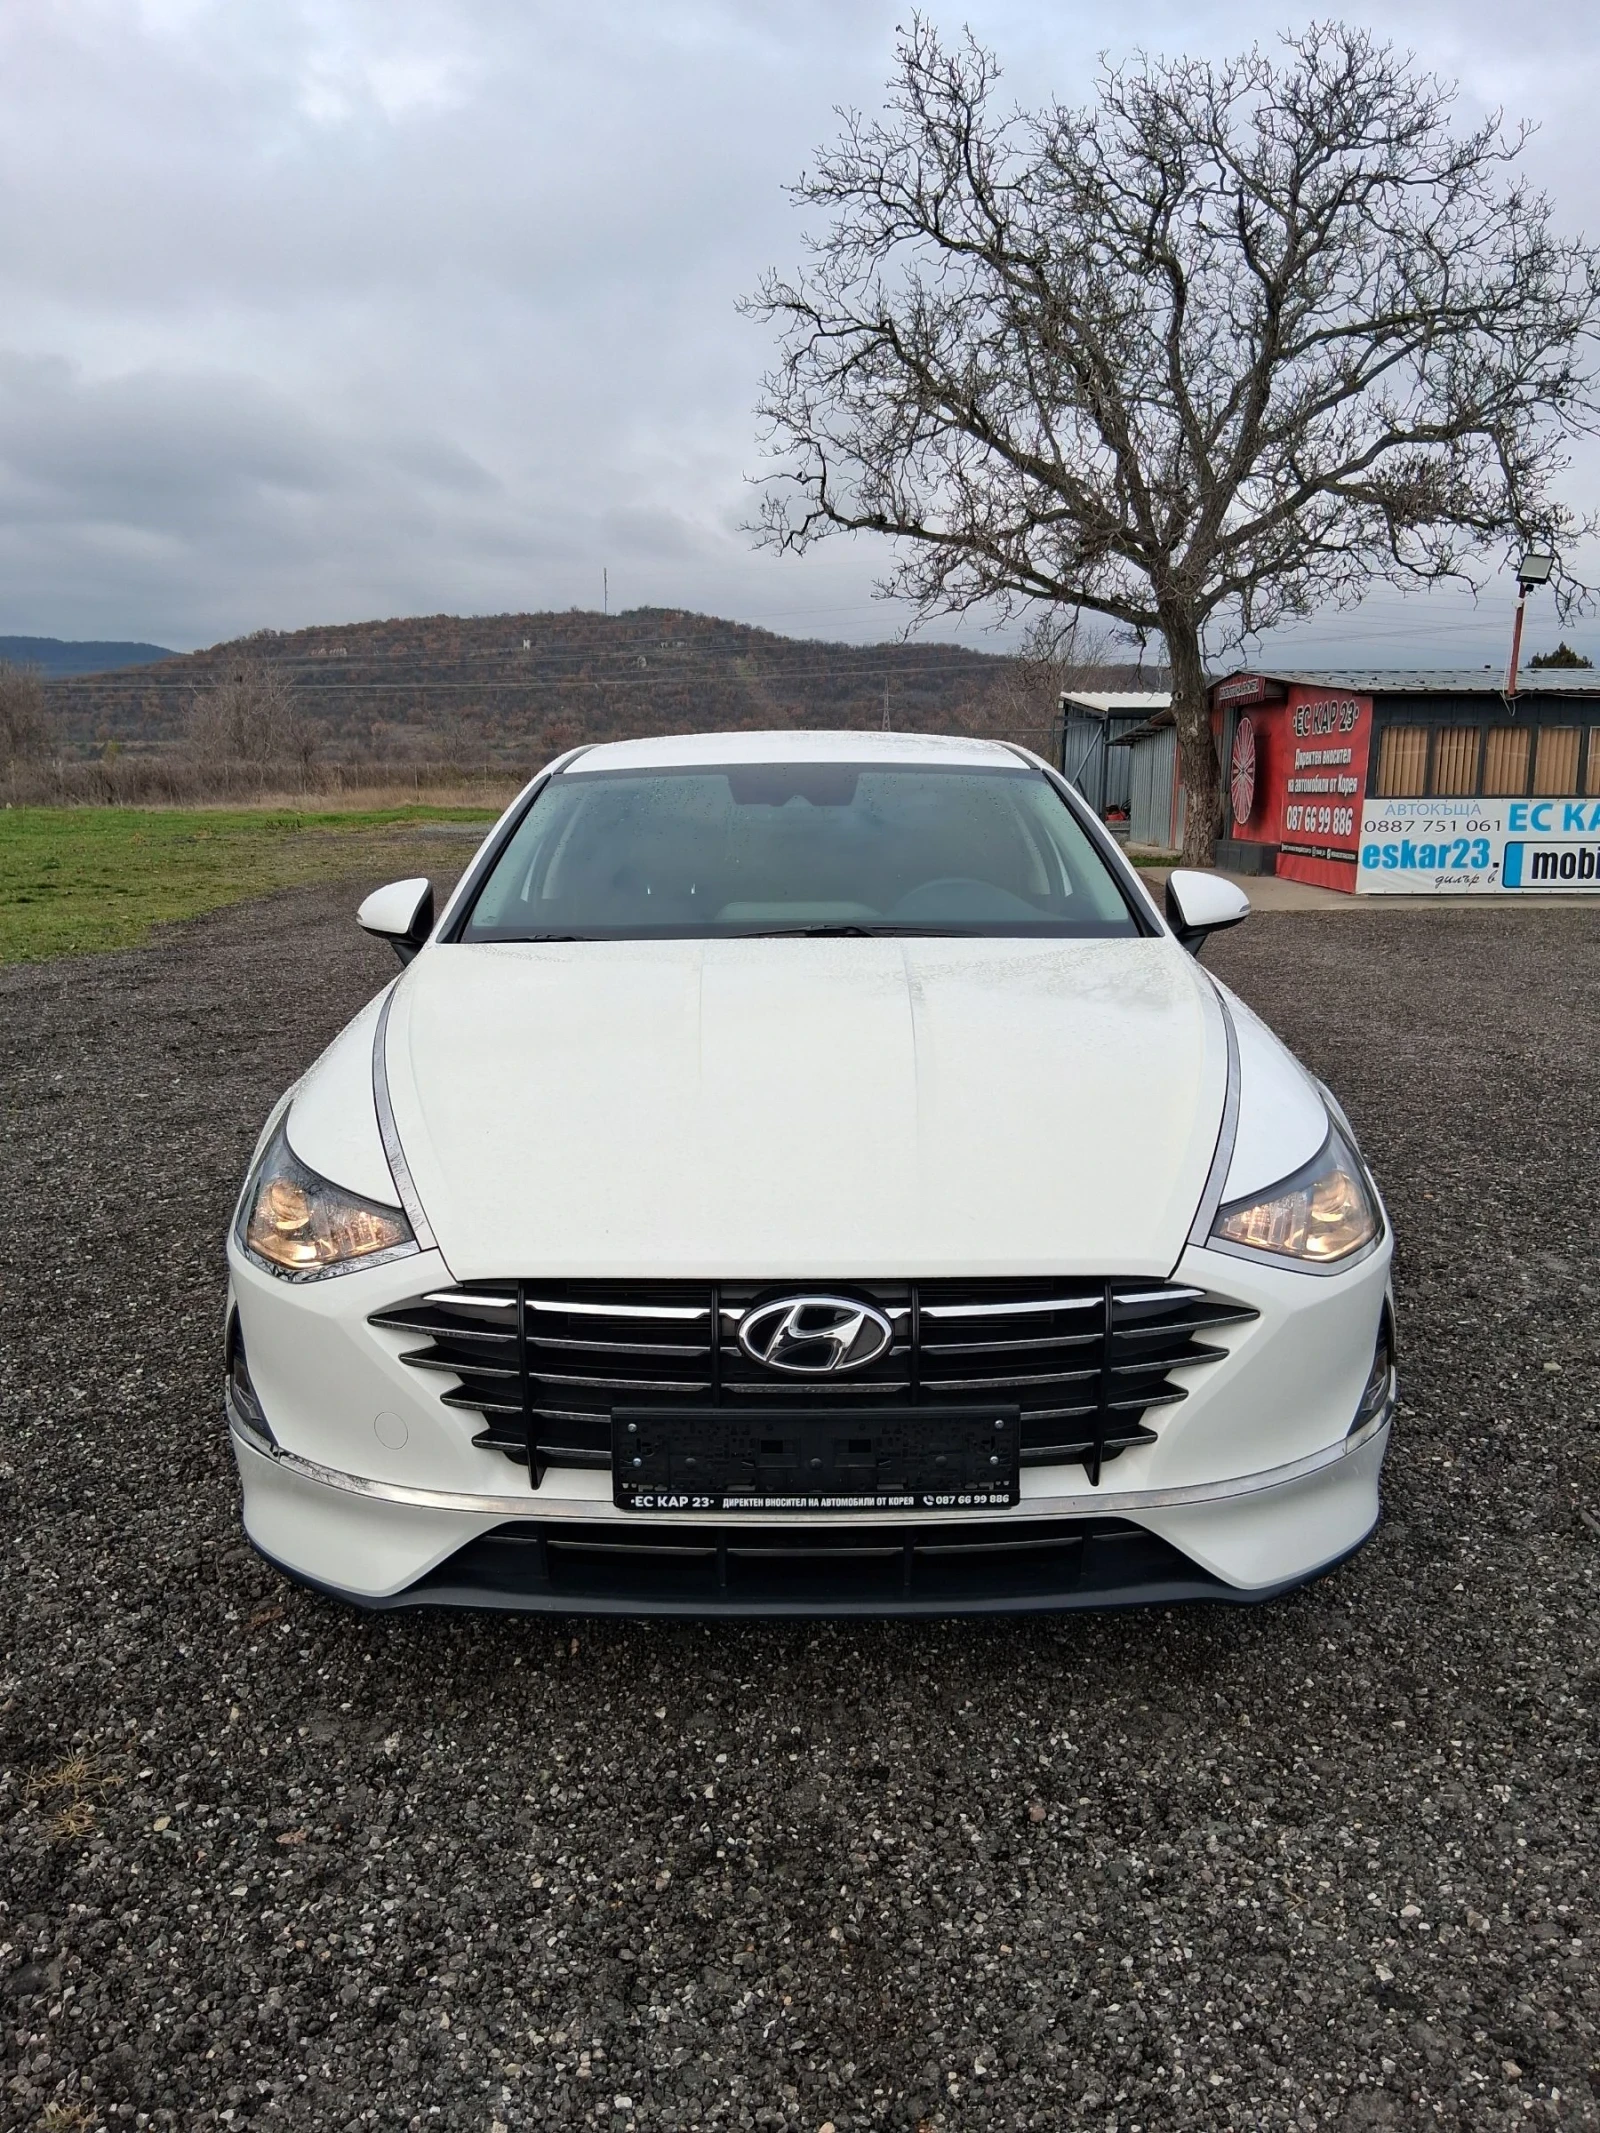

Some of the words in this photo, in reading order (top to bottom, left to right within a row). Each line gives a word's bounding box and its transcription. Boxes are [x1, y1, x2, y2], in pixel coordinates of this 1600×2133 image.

[1312, 700, 1338, 735] КАР
[1295, 748, 1321, 769] Директен
[1322, 748, 1351, 764] вносител
[1287, 778, 1294, 792] на
[1295, 774, 1328, 792] автомобили
[1329, 777, 1337, 792] от
[1338, 774, 1357, 796] Корея
[1385, 803, 1481, 817] АВТОКЪЩА
[1508, 803, 1554, 831] ЕС
[1286, 805, 1303, 830] 087
[1304, 806, 1316, 832] 66
[1318, 806, 1331, 833] 99
[1332, 807, 1353, 836] 886
[1364, 820, 1415, 832] 0887
[1422, 820, 1456, 832] 751
[1466, 820, 1500, 832] 061
[657, 1496, 688, 1507] КАР
[723, 1498, 763, 1508] ДИРЕКТЕН
[765, 1498, 806, 1507] ВНОСИТЕЛ
[809, 1498, 819, 1507] НА
[821, 1498, 874, 1506] АВТОМОБИЛИ
[877, 1497, 886, 1506] ОТ
[888, 1497, 914, 1505] КОРЕЯ
[936, 1496, 955, 1504] 087
[958, 1496, 971, 1504] 66
[974, 1495, 987, 1504] 99
[990, 1495, 1009, 1503] 886
